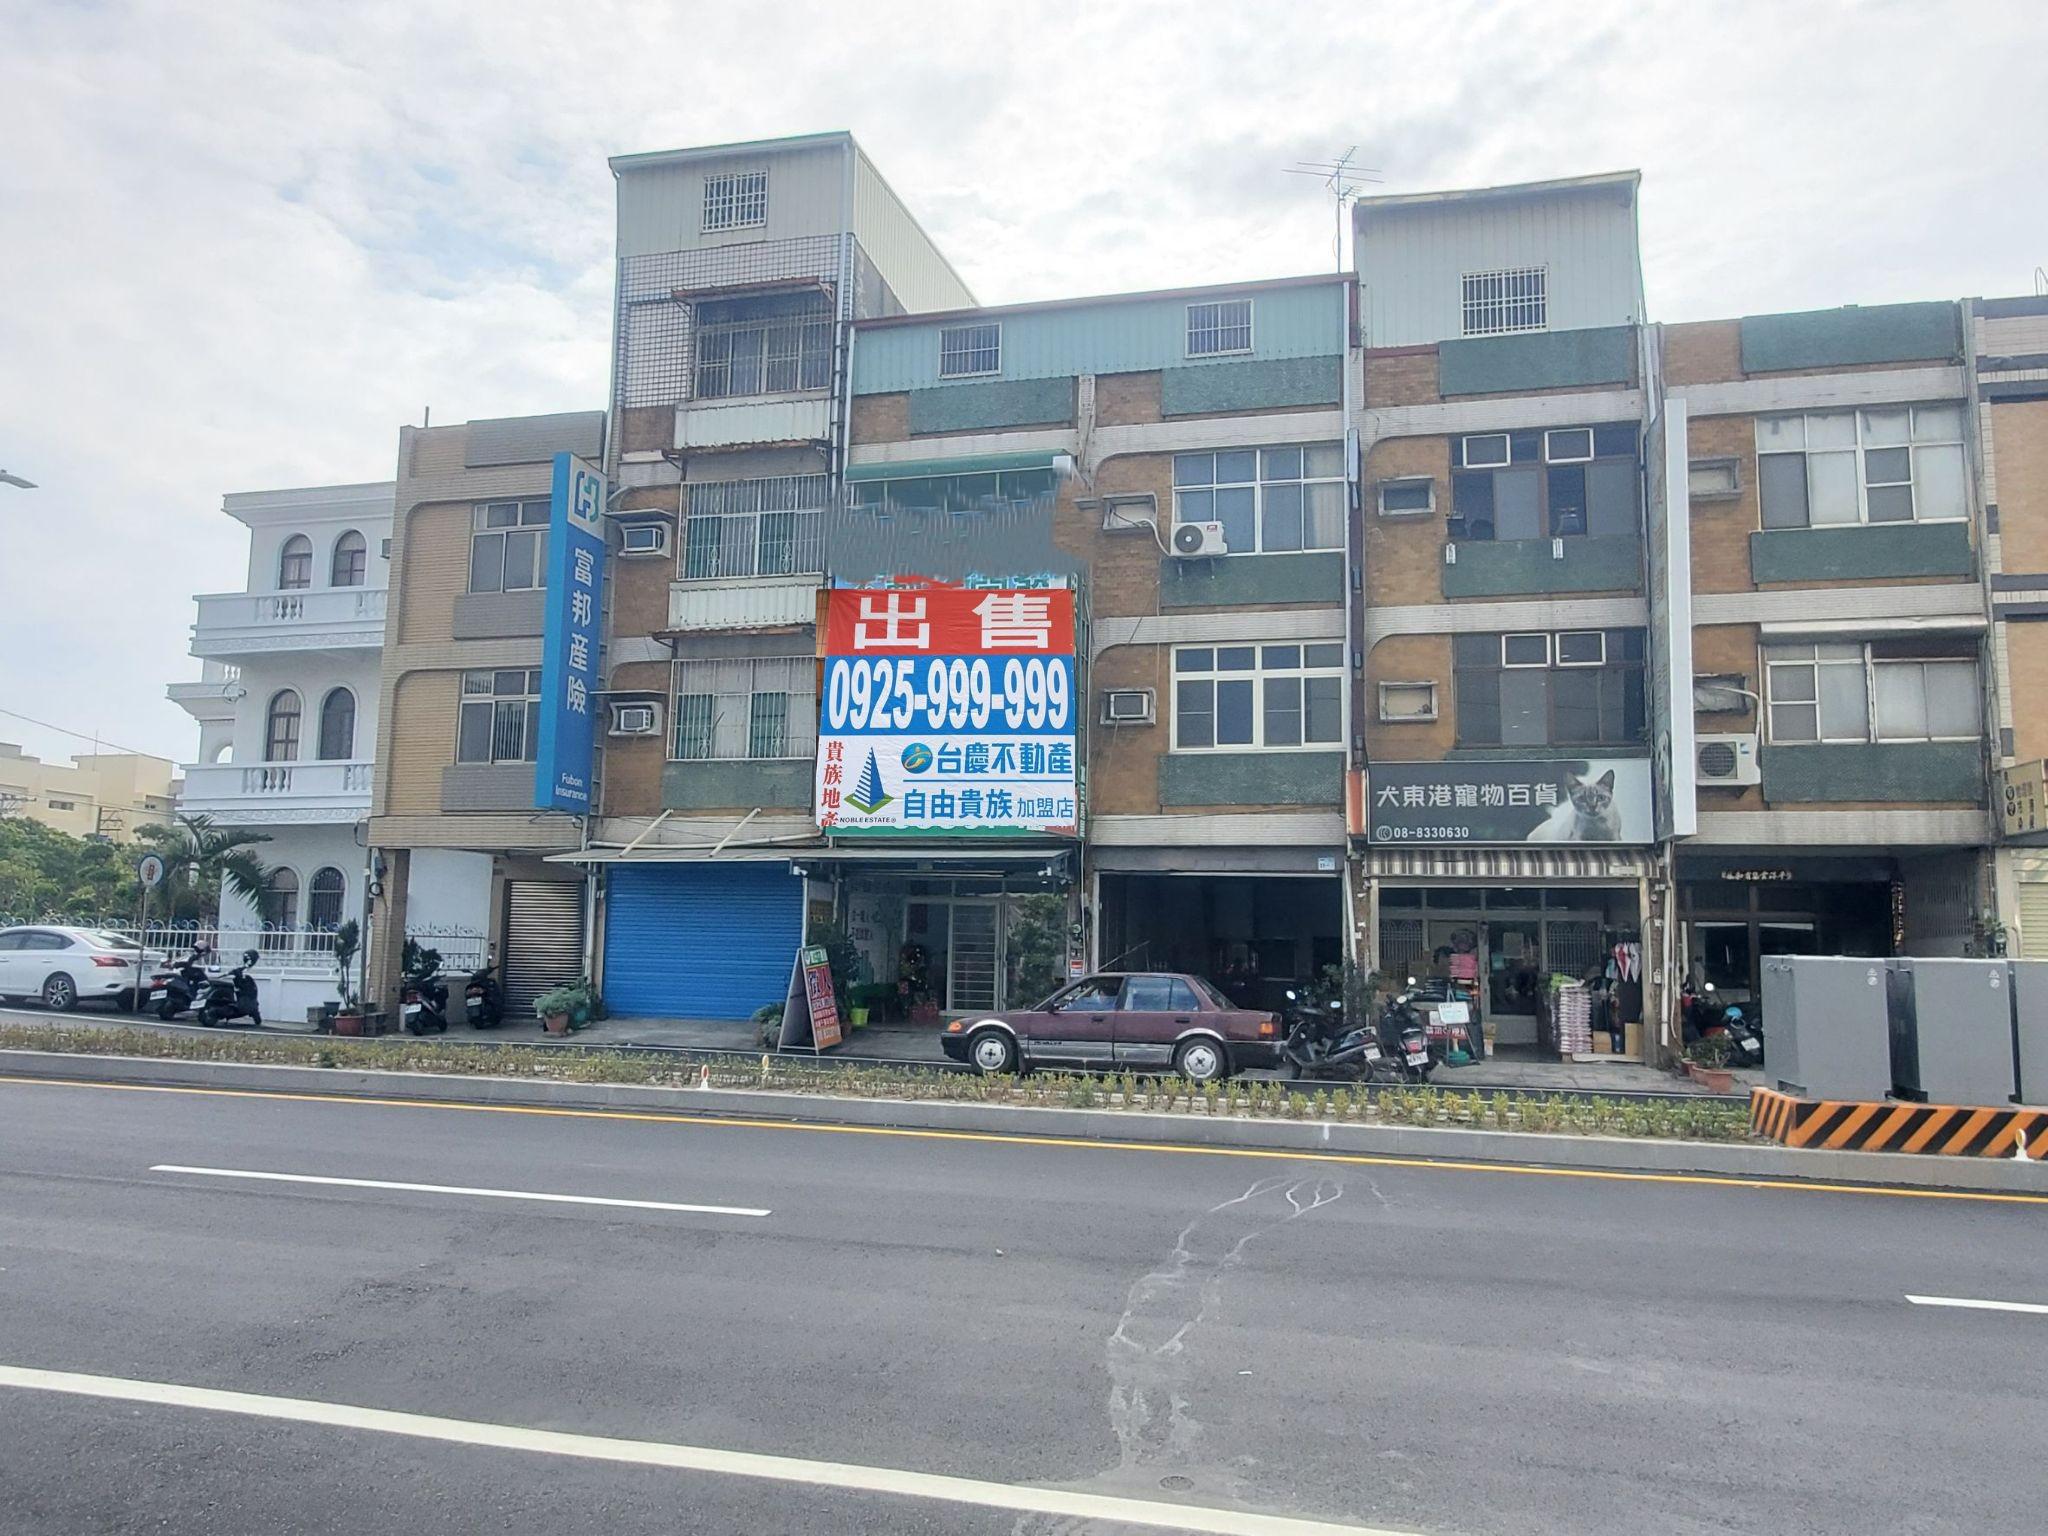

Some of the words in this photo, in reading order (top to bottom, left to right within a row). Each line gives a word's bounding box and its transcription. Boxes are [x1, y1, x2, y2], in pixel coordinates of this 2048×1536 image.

[853, 593, 1052, 650] 出售
[828, 657, 1068, 730] 0925-999-999
[937, 741, 1073, 775] 台慶不動產
[561, 772, 583, 787] Fubon
[555, 784, 588, 802] Insurance
[1376, 782, 1559, 808] 犬東港寵物百貨
[839, 816, 864, 824] NOBLE
[1393, 825, 1470, 839] 08-8330630
